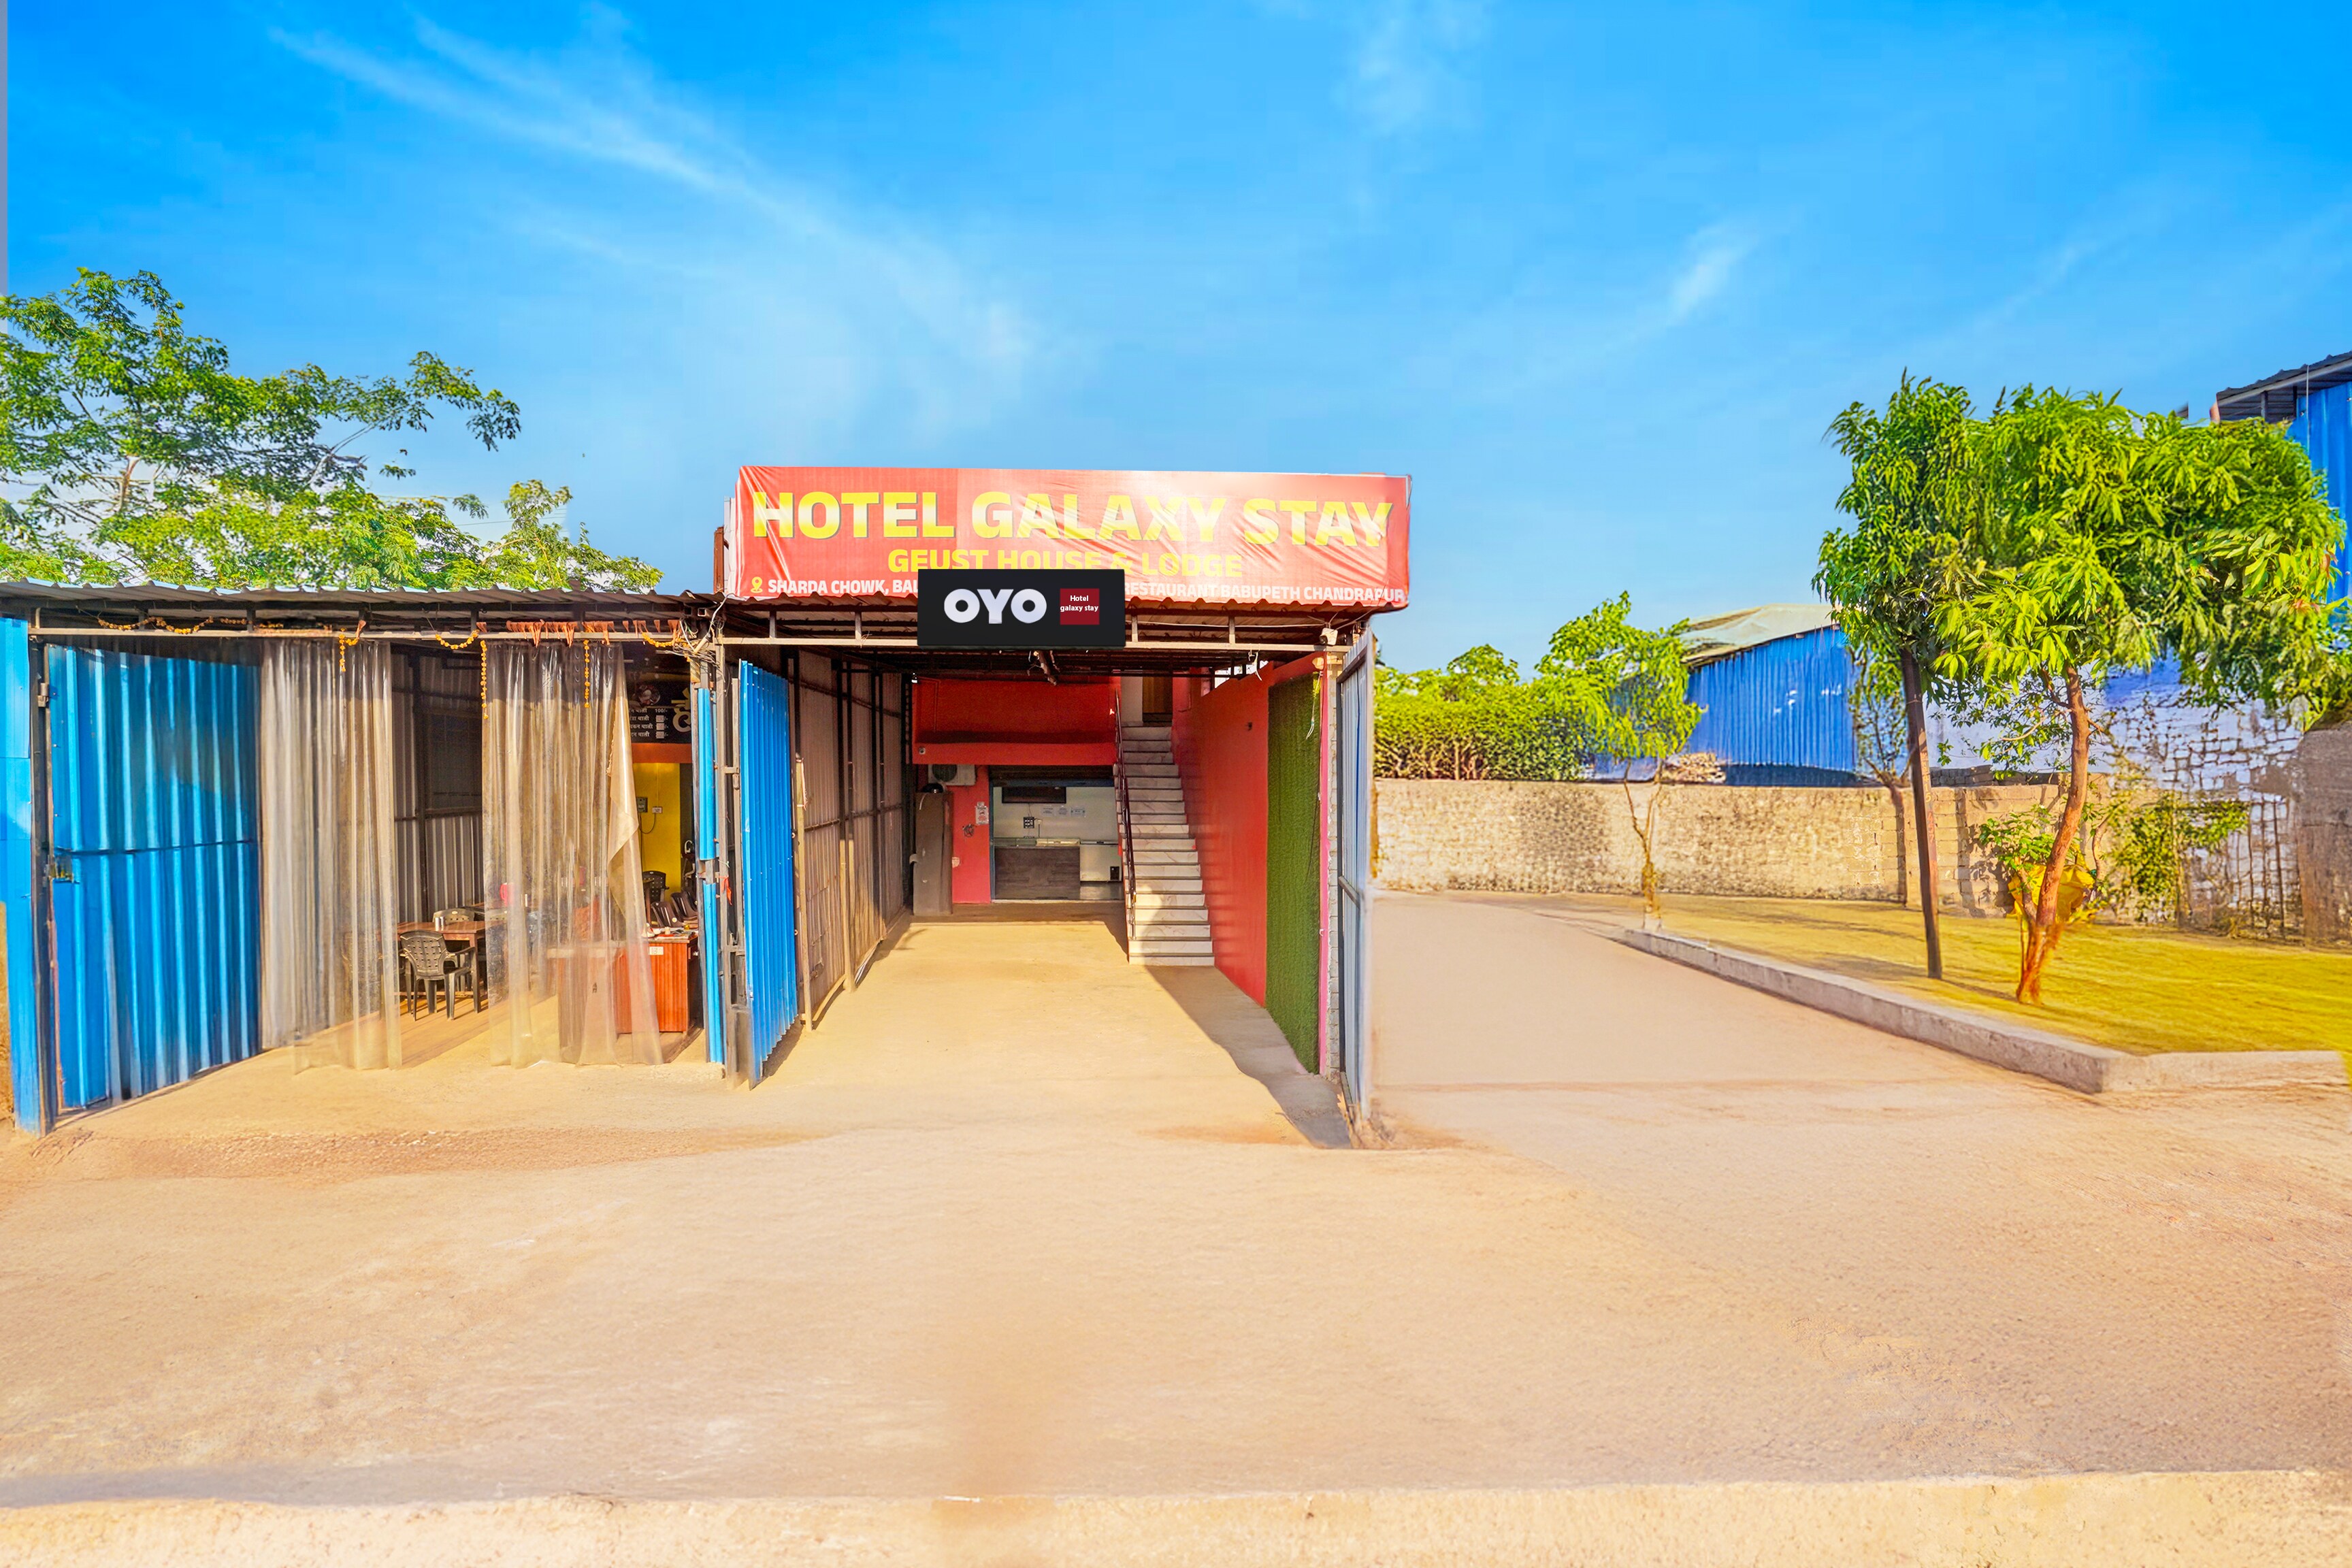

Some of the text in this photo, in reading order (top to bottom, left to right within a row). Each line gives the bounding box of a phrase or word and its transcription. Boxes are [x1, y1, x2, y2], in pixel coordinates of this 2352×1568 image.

[753, 491, 1393, 547] HOTEL GALAXY STAY
[888, 549, 989, 573] GEUST
[997, 549, 1102, 570] HOUSE
[1142, 552, 1243, 577] LODGE
[768, 579, 828, 593] SHARDA
[831, 580, 889, 595] CHOWK,
[1125, 582, 1221, 598] RESTAURANT
[1221, 585, 1301, 600] BABUPETH
[1303, 587, 1405, 602] CHANDRAPUR
[944, 588, 1047, 624] OYO
